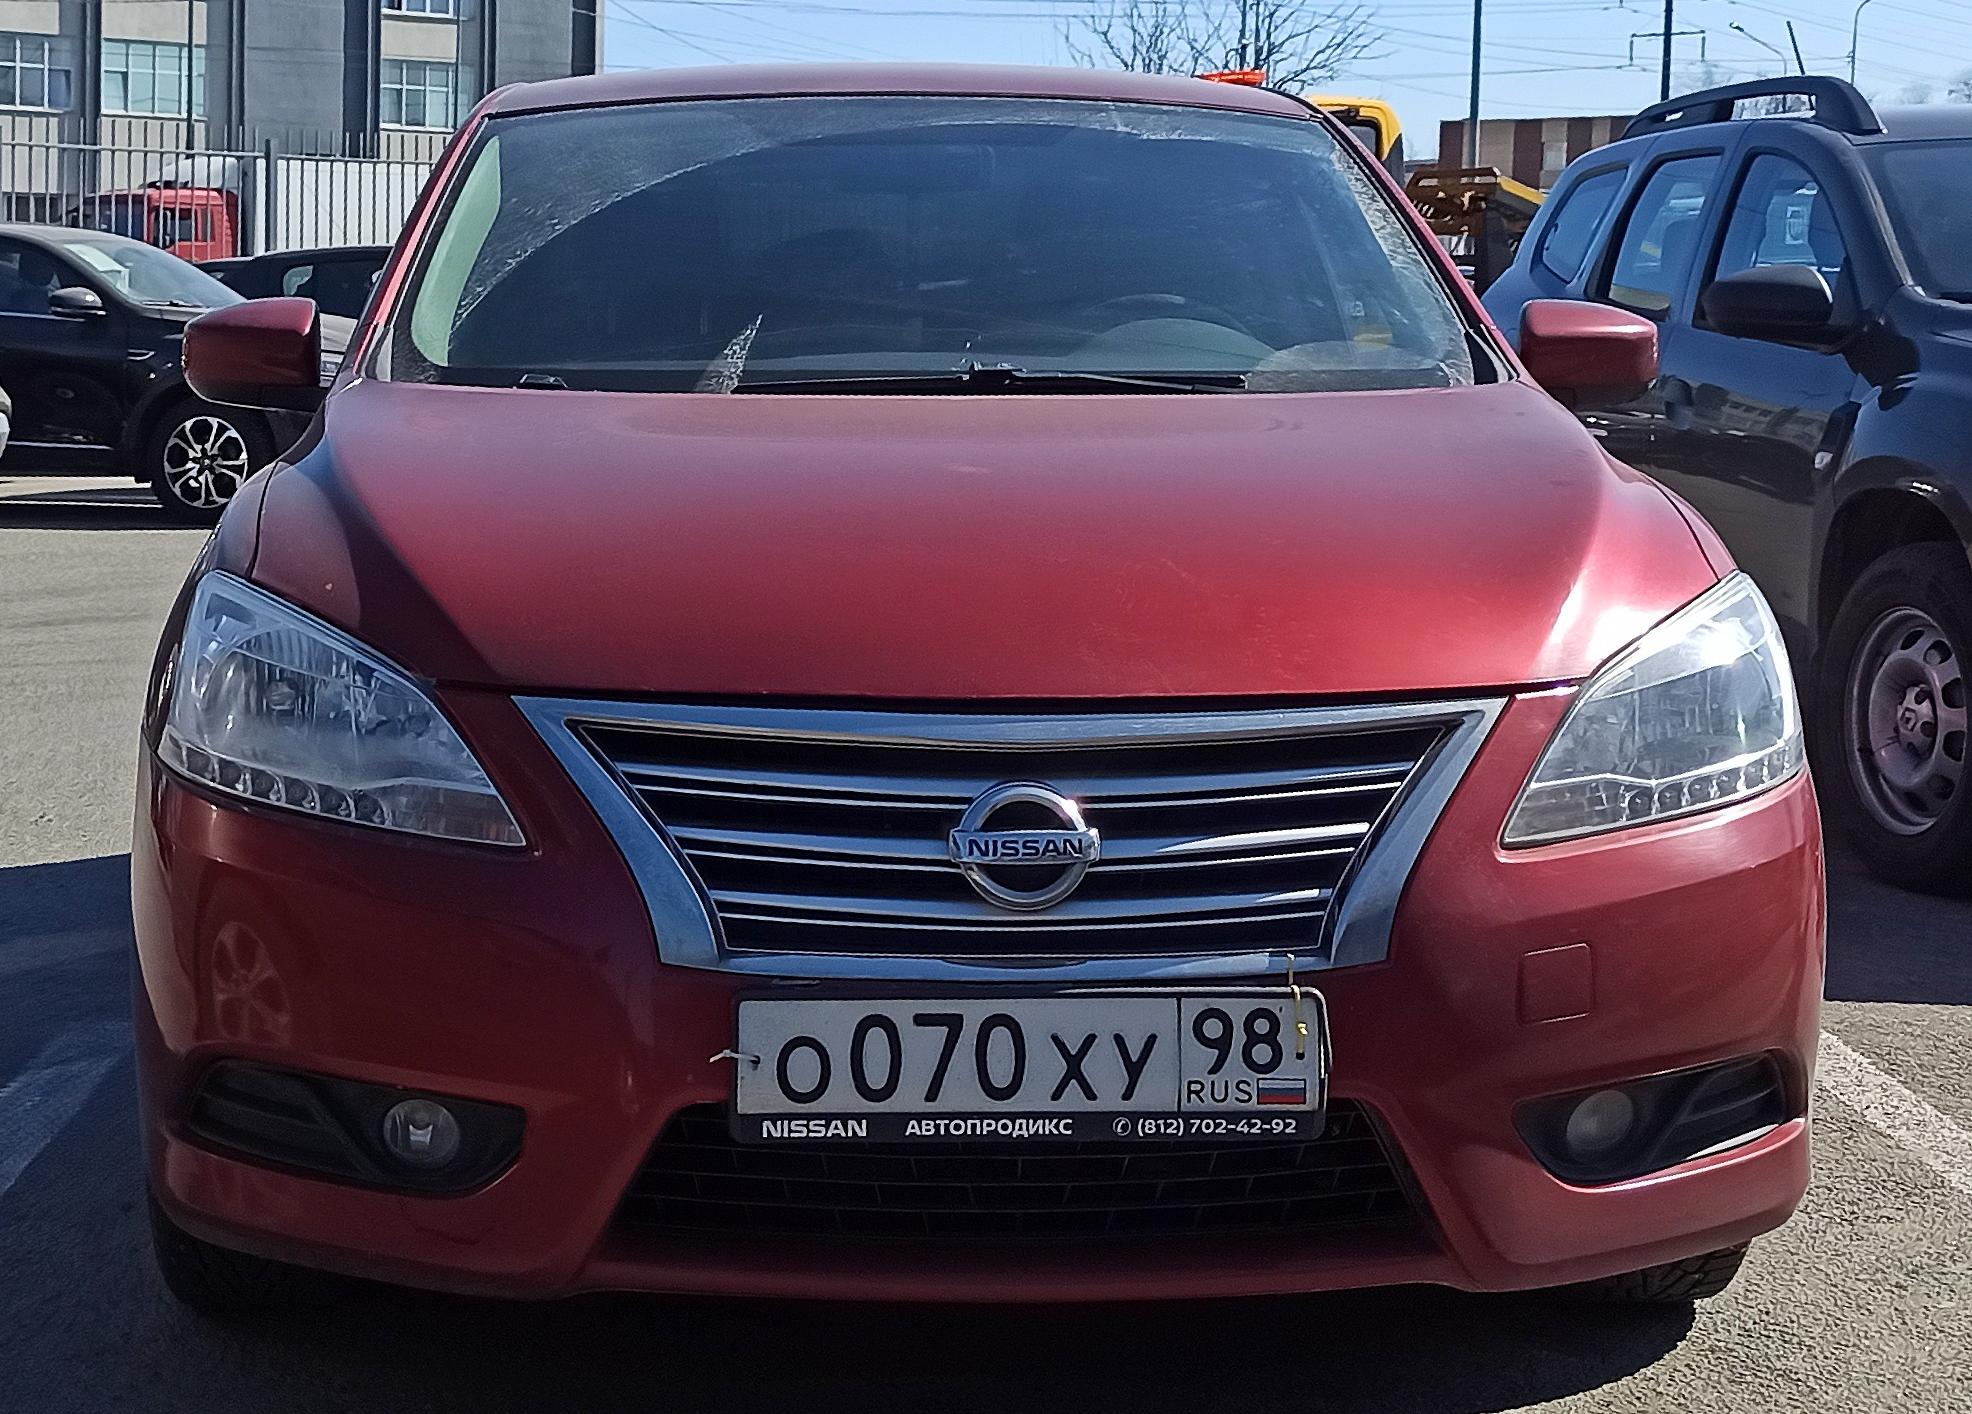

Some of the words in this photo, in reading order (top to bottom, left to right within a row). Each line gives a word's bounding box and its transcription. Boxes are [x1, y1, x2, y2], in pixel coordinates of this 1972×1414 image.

[967, 838, 1083, 858] NISSAN
[1192, 1007, 1283, 1075] 98
[1186, 1079, 1253, 1103] RUS
[762, 1119, 867, 1138] NISSAN
[905, 1118, 1073, 1138] АВТОПРОДИКС
[1137, 1118, 1184, 1136] (812)
[1189, 1118, 1297, 1134] 702-42-92
